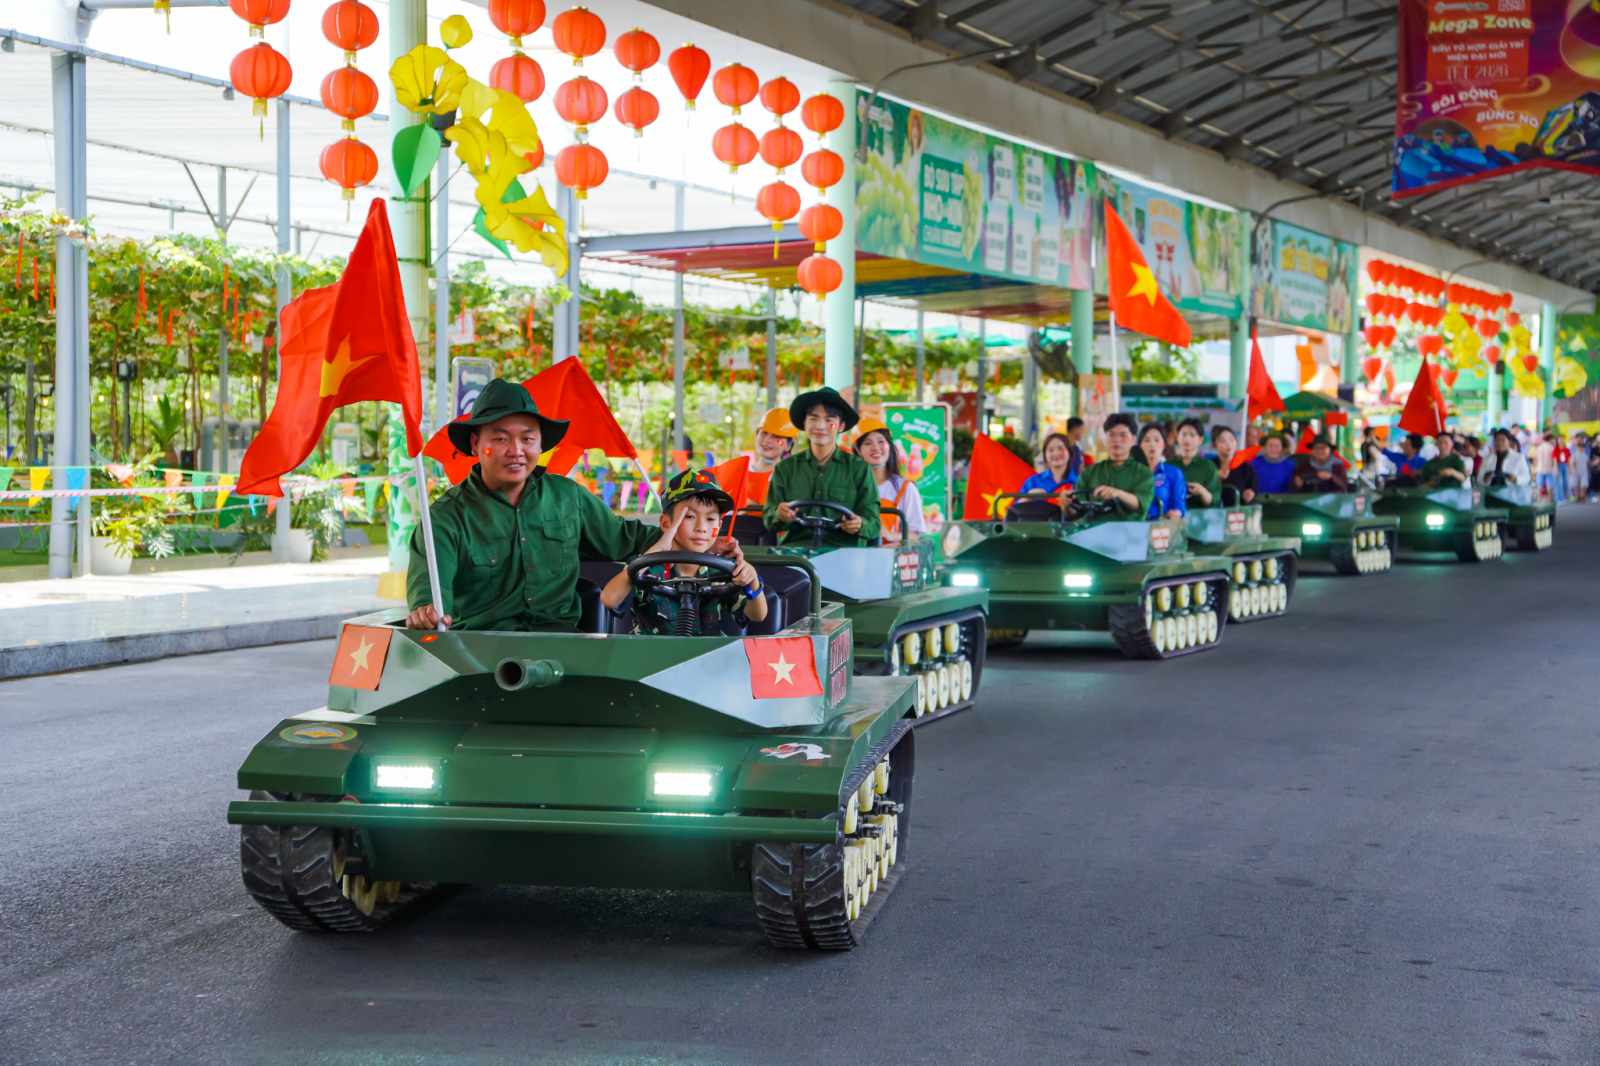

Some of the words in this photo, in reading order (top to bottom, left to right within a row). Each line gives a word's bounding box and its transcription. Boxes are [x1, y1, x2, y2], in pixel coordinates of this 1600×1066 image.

[1428, 18, 1479, 35] Mega
[1484, 14, 1532, 29] Zone
[1475, 63, 1508, 79] 2026
[1431, 94, 1456, 114] SÔI
[1458, 86, 1499, 103] ĐỘNG
[1476, 107, 1515, 124] BÙNG
